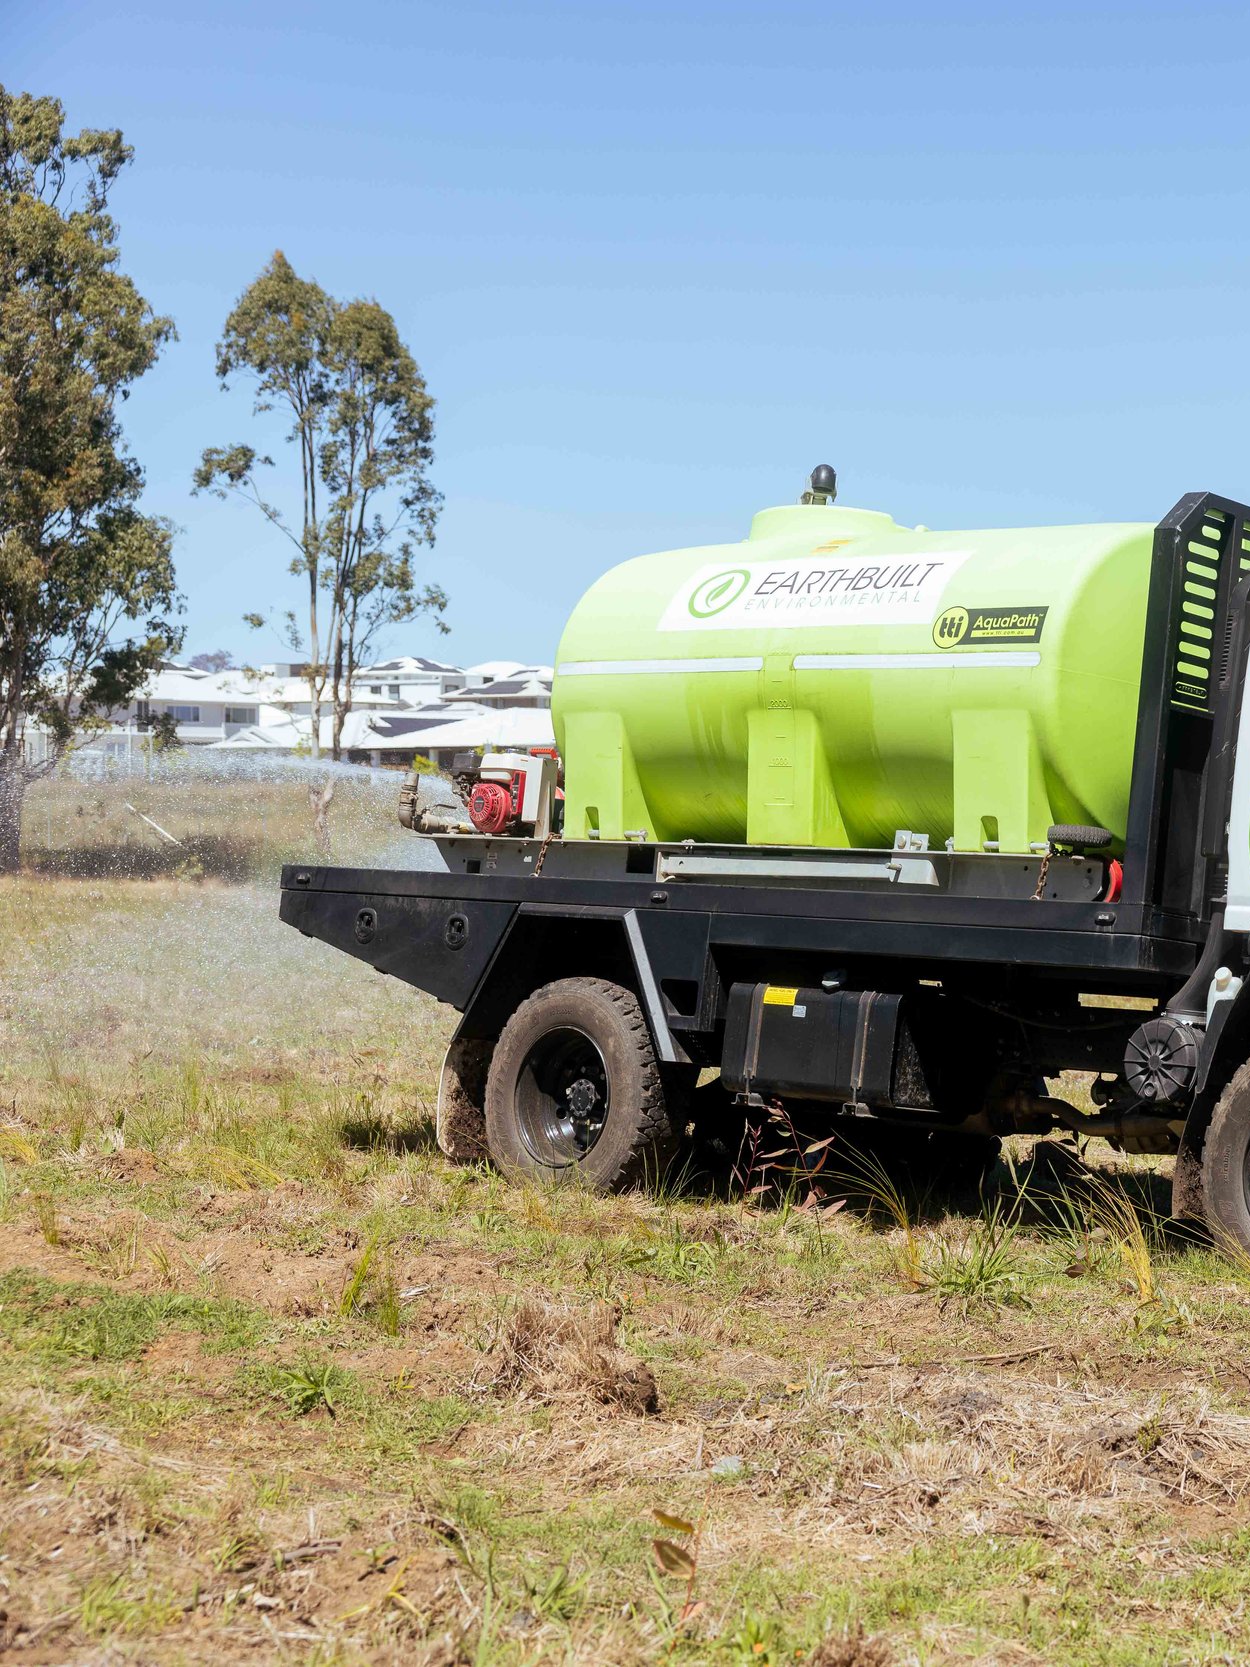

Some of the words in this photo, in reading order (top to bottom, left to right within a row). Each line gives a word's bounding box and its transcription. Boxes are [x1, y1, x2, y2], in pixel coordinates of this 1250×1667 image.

[754, 562, 944, 595] EARTHBUILT
[744, 590, 920, 610] ENVIRONMENTAL
[938, 616, 964, 639] tti
